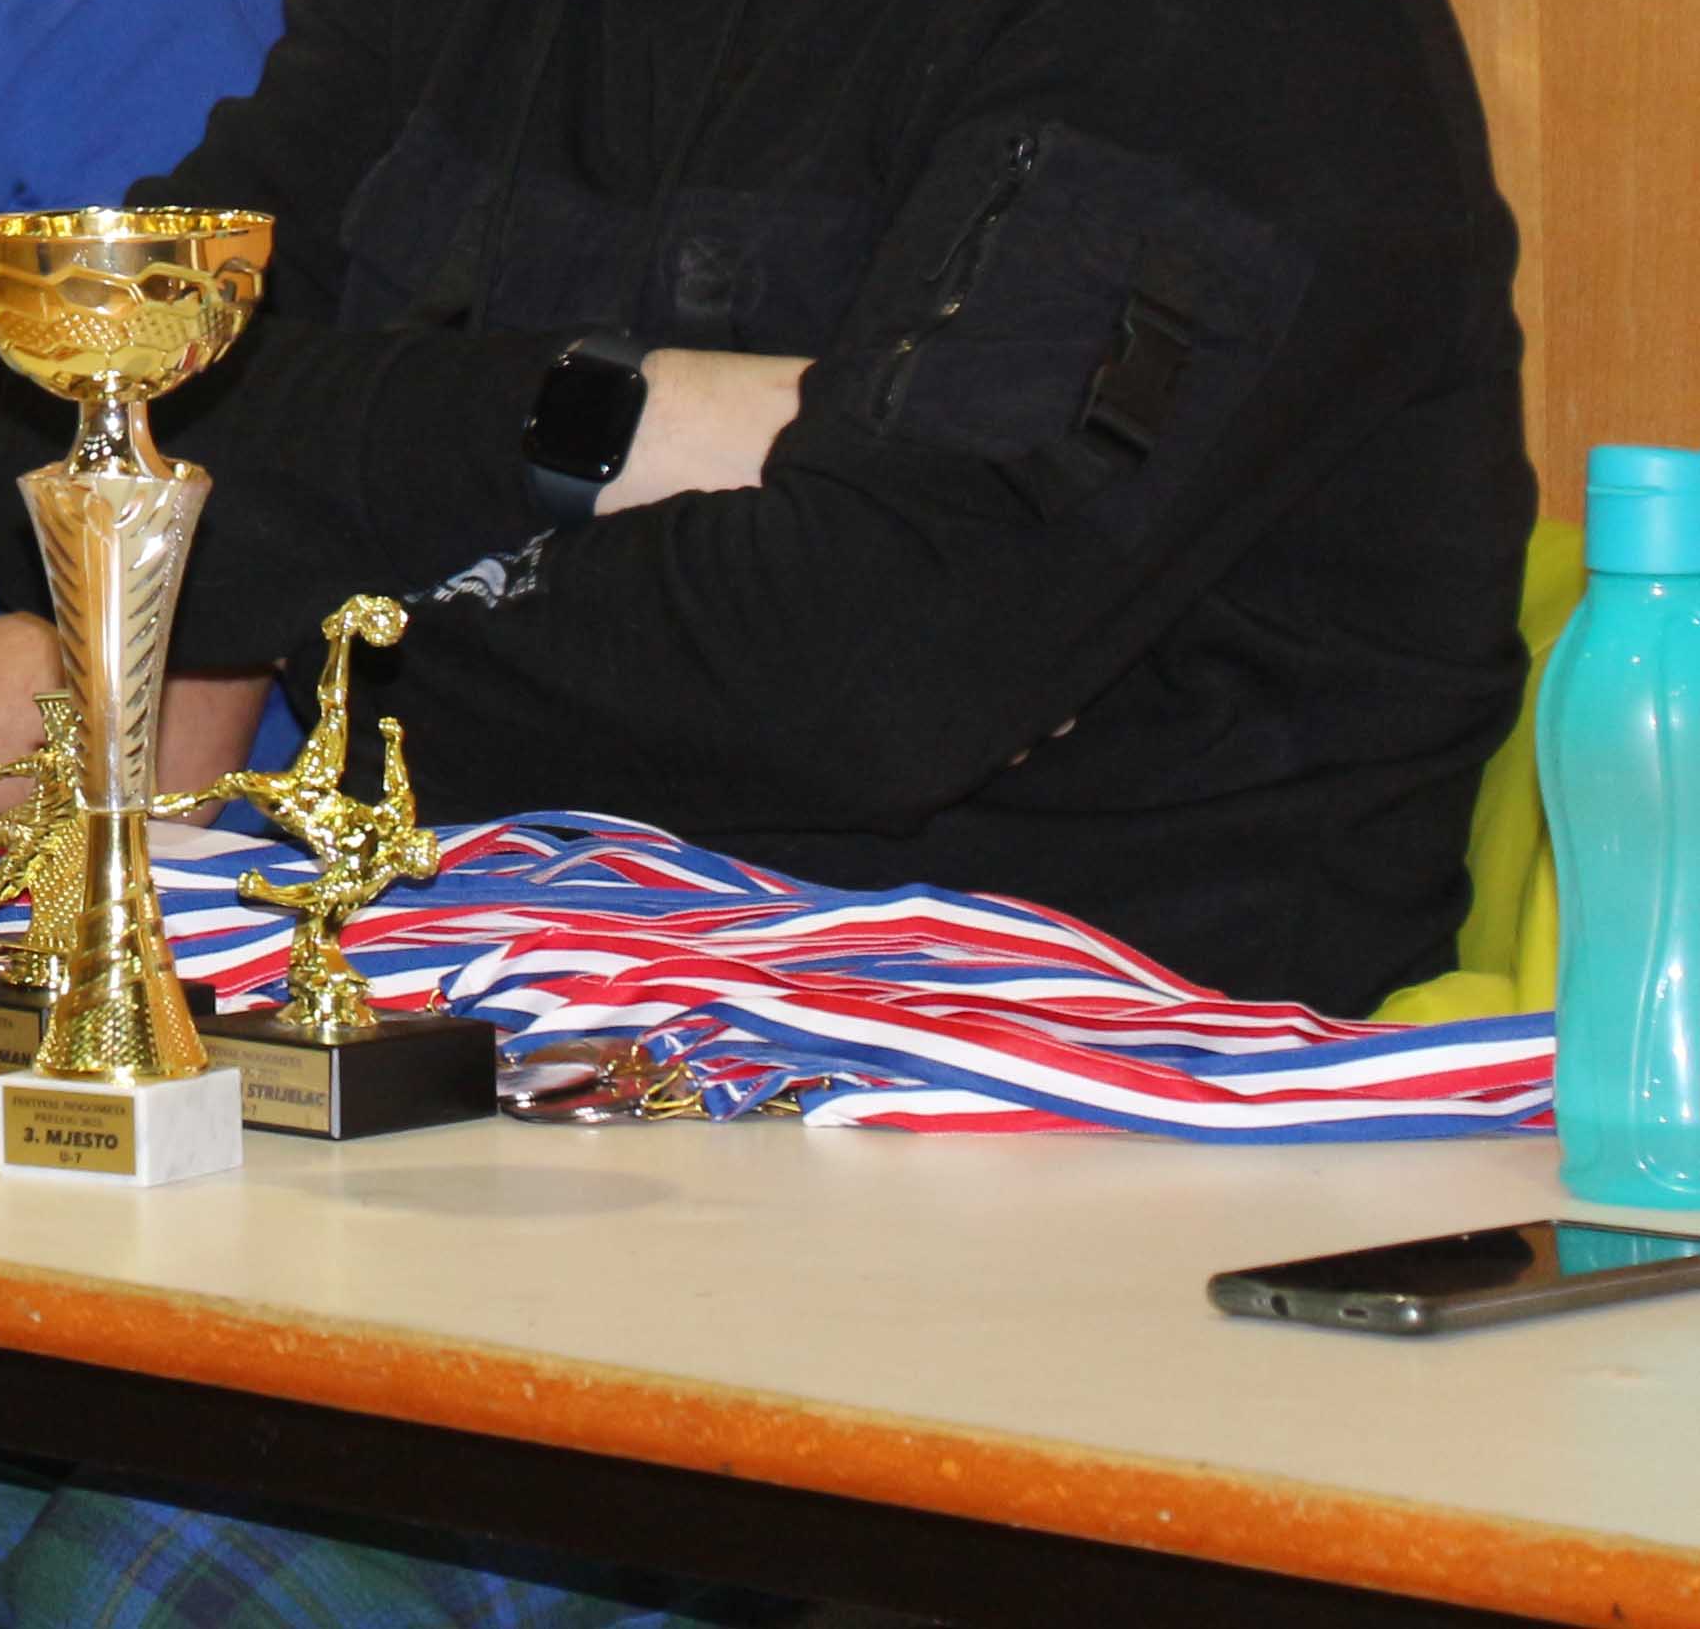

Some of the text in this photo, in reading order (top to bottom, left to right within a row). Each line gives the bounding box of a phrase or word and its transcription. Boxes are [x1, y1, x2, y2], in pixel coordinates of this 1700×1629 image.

[247, 1083, 327, 1107] STRIJELAC
[23, 1127, 119, 1150] 3. MJESTO
[59, 1151, 82, 1164] U-7
